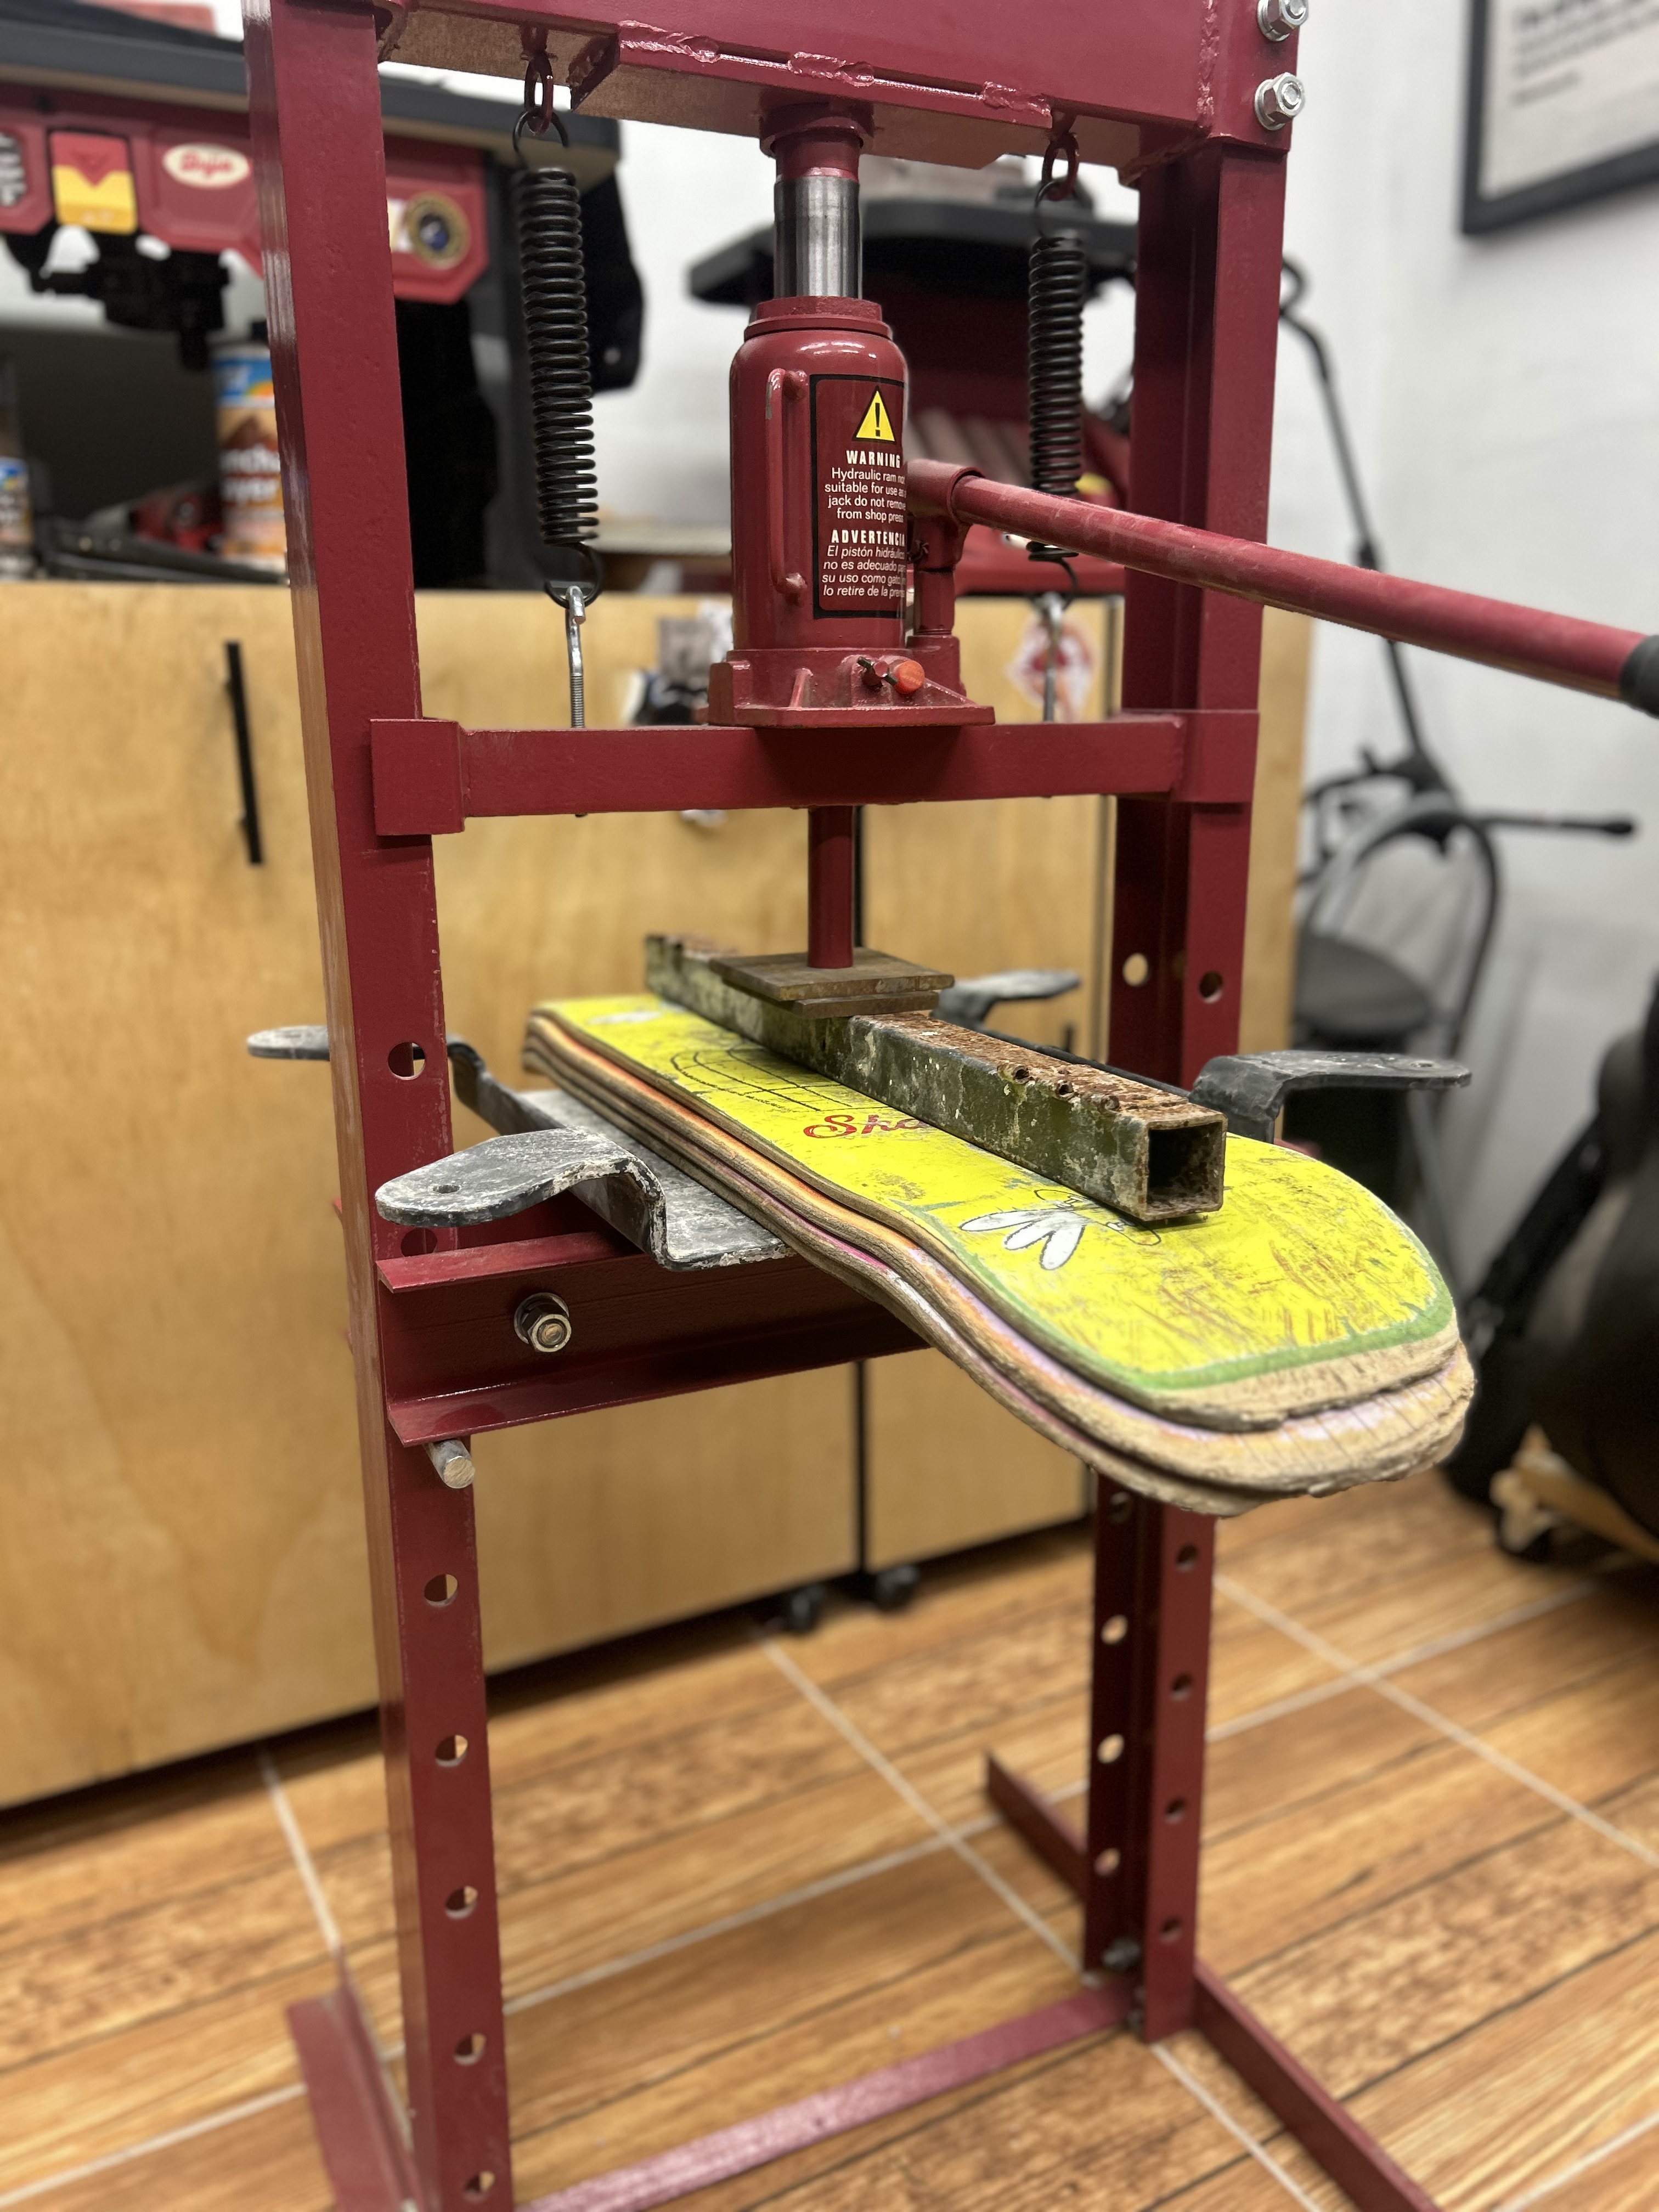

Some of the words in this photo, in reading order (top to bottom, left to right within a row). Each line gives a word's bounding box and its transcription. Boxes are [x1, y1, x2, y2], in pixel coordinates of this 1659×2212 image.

[846, 450, 900, 469] WARNING
[832, 467, 881, 482] Hydraulic
[883, 473, 897, 482] ram
[825, 481, 868, 493] suitable
[871, 482, 884, 494] for
[885, 487, 898, 496] use
[827, 494, 852, 509] jack
[854, 494, 867, 506] do
[870, 497, 885, 507] not
[837, 507, 862, 520] from
[865, 509, 887, 523] shop
[831, 529, 905, 546] ADVERTENCIA
[827, 545, 839, 557] El
[840, 545, 873, 559] pistón
[823, 561, 838, 569] no
[841, 561, 854, 570] es
[856, 558, 897, 572] adecuado
[822, 574, 836, 583] su
[839, 574, 859, 583] uso
[861, 574, 887, 584] como
[823, 584, 834, 596] lo
[837, 585, 865, 596] retire
[867, 585, 879, 596] de
[881, 585, 888, 597] la
